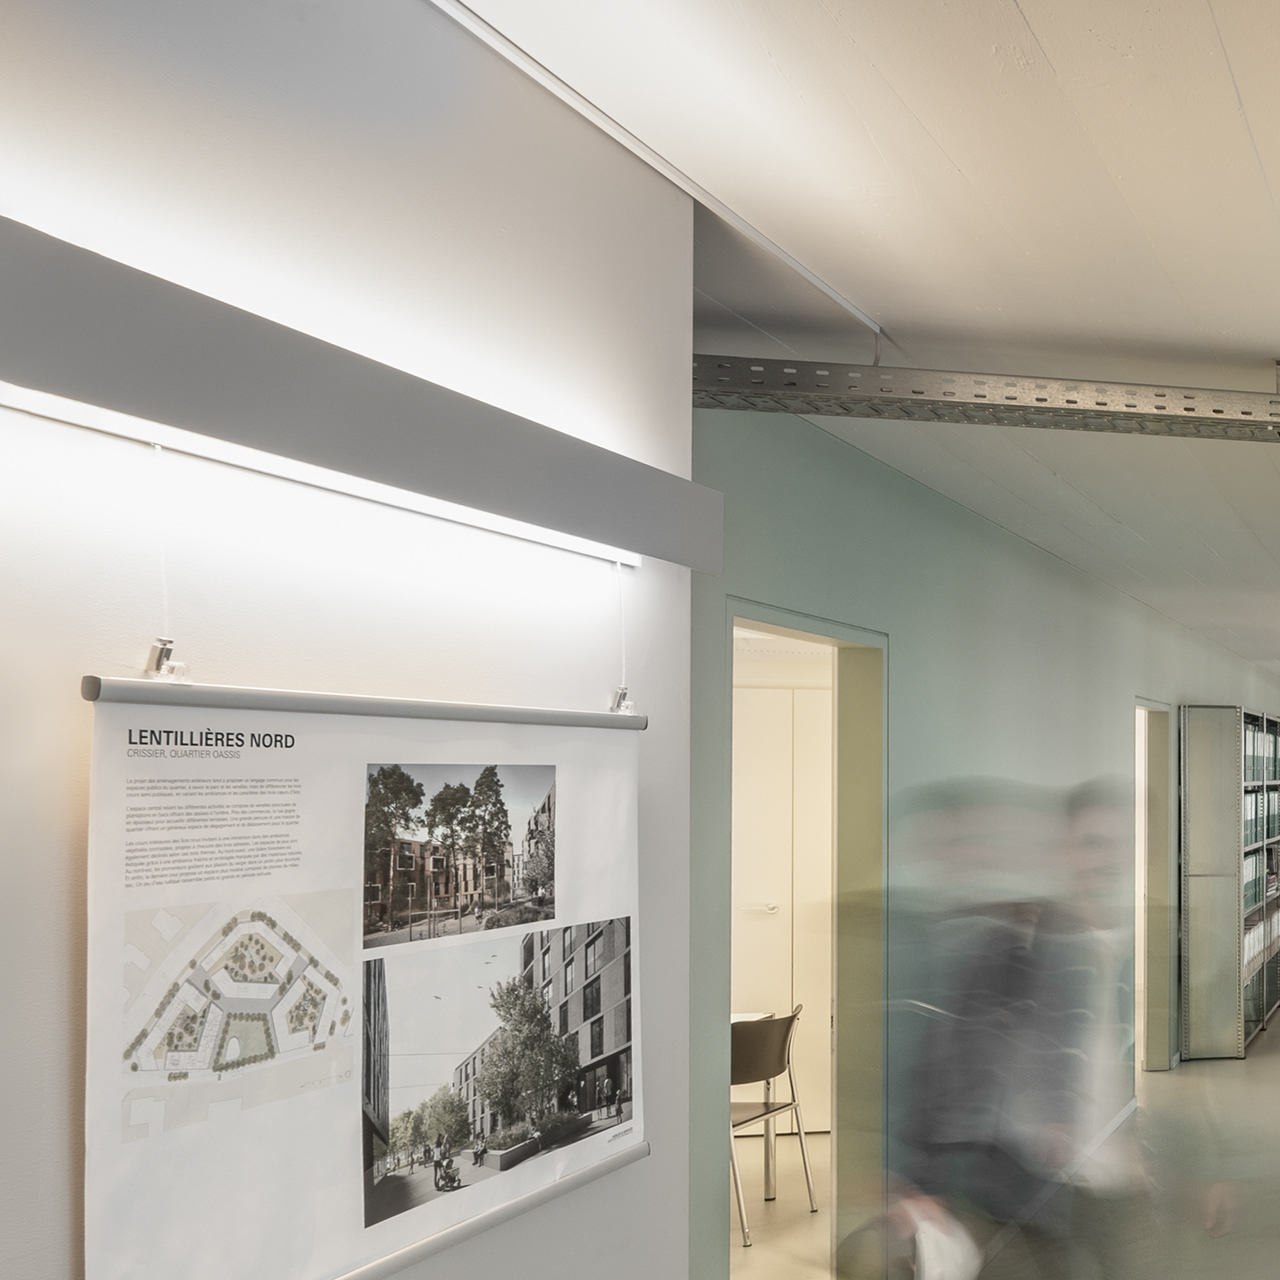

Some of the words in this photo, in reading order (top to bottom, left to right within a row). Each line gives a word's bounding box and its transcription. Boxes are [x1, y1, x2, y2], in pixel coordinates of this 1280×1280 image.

[128, 728, 245, 748] LENTILLIÈRES
[250, 733, 296, 749] NORD
[127, 748, 168, 759] CRISSIER,
[169, 749, 211, 759] QUARTIER
[213, 750, 241, 759] OASSIS
